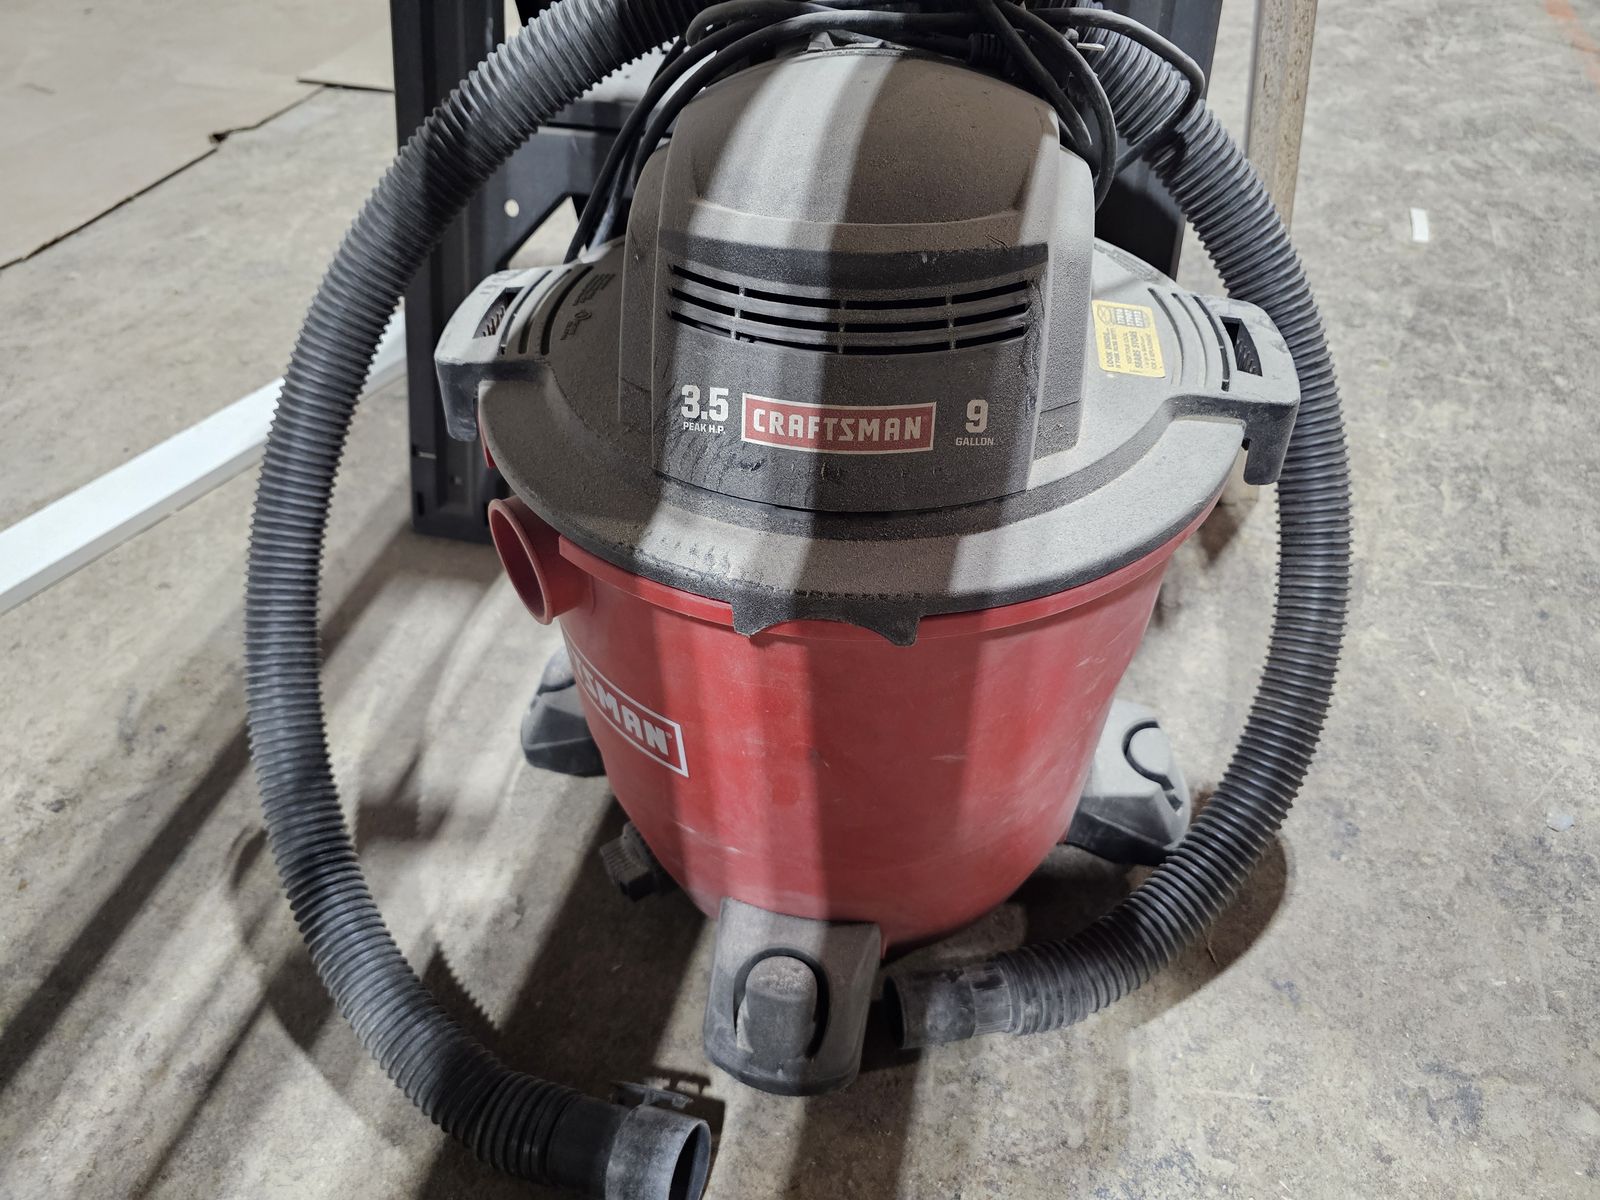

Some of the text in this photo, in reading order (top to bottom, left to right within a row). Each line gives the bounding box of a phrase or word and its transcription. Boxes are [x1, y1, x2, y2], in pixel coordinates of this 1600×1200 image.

[681, 384, 729, 422] 3.5
[965, 399, 989, 433] 9
[683, 421, 726, 435] PEAK H.P.
[753, 407, 922, 442] CRAFTSMAN
[955, 437, 994, 446] GALLON
